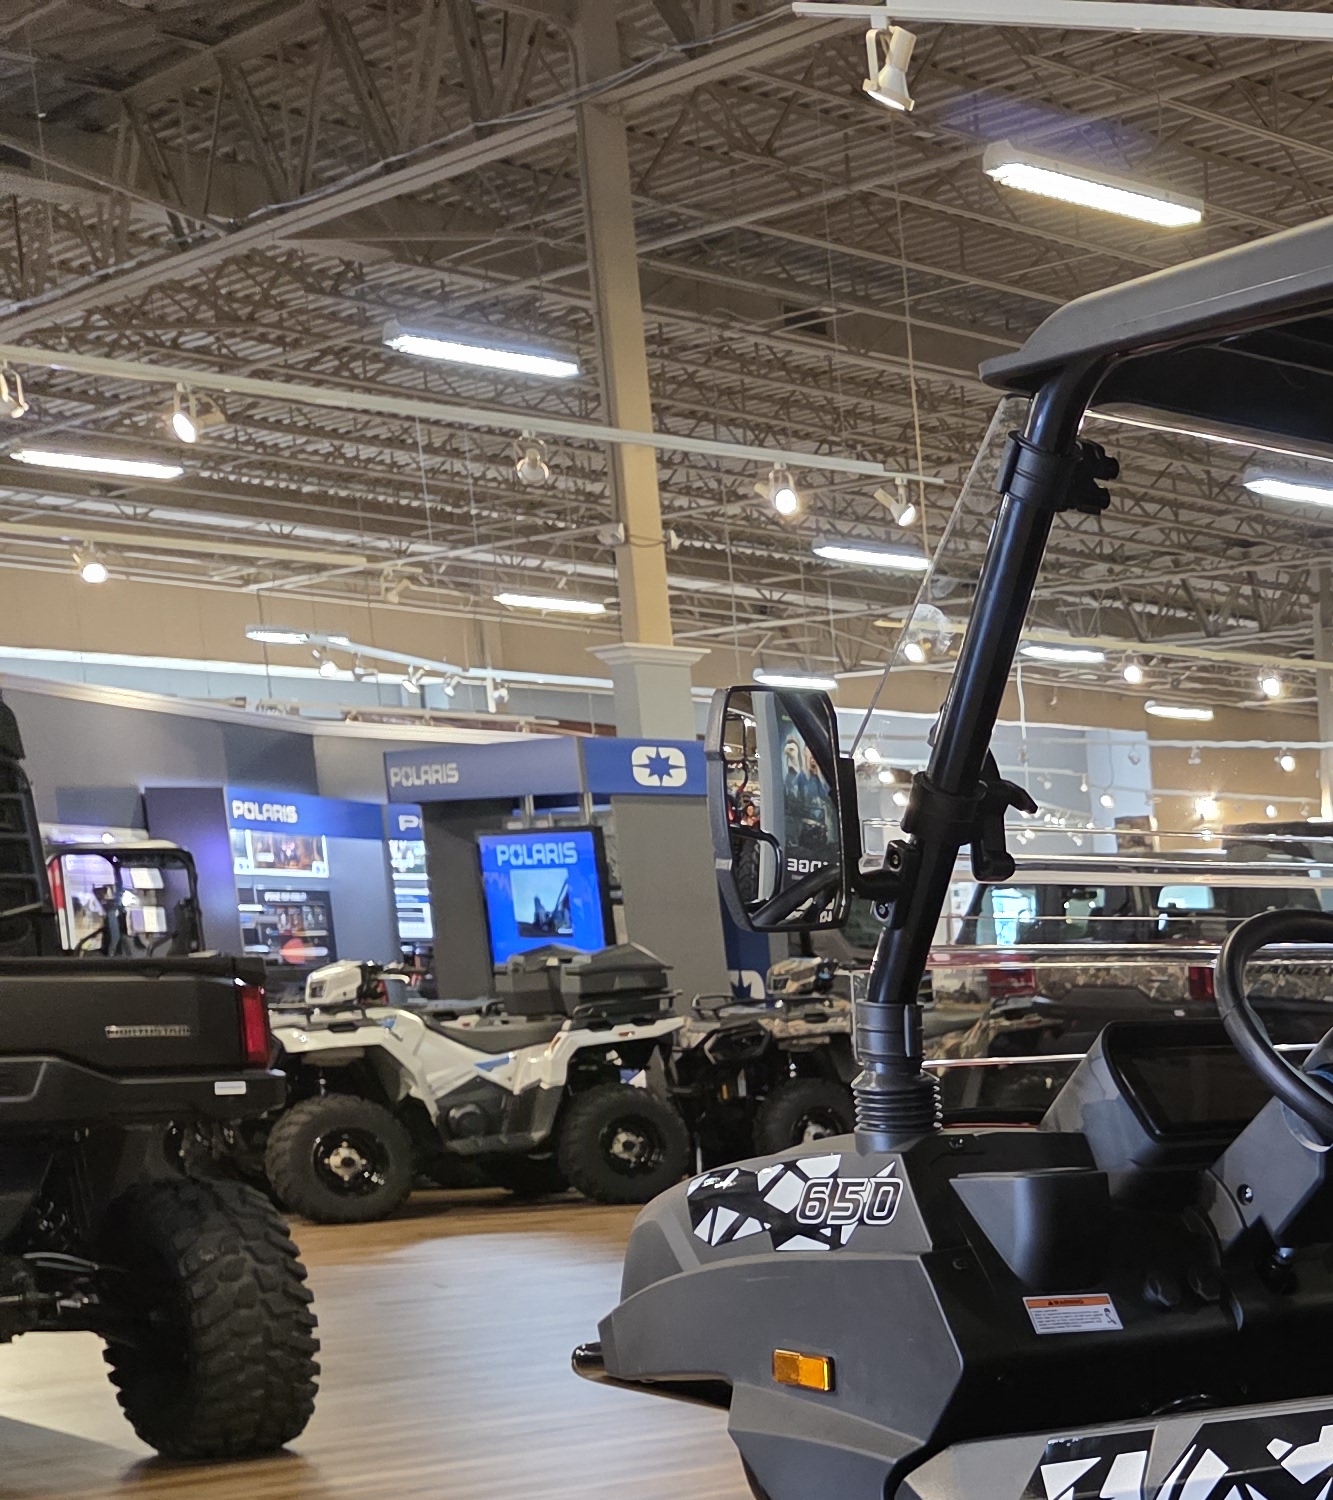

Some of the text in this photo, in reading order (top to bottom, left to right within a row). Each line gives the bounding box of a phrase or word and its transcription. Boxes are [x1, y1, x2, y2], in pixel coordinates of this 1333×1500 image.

[390, 763, 459, 788] POLARIS
[231, 800, 299, 824] POLARIS
[495, 841, 578, 866] POLARIS
[796, 1177, 903, 1226] 650
